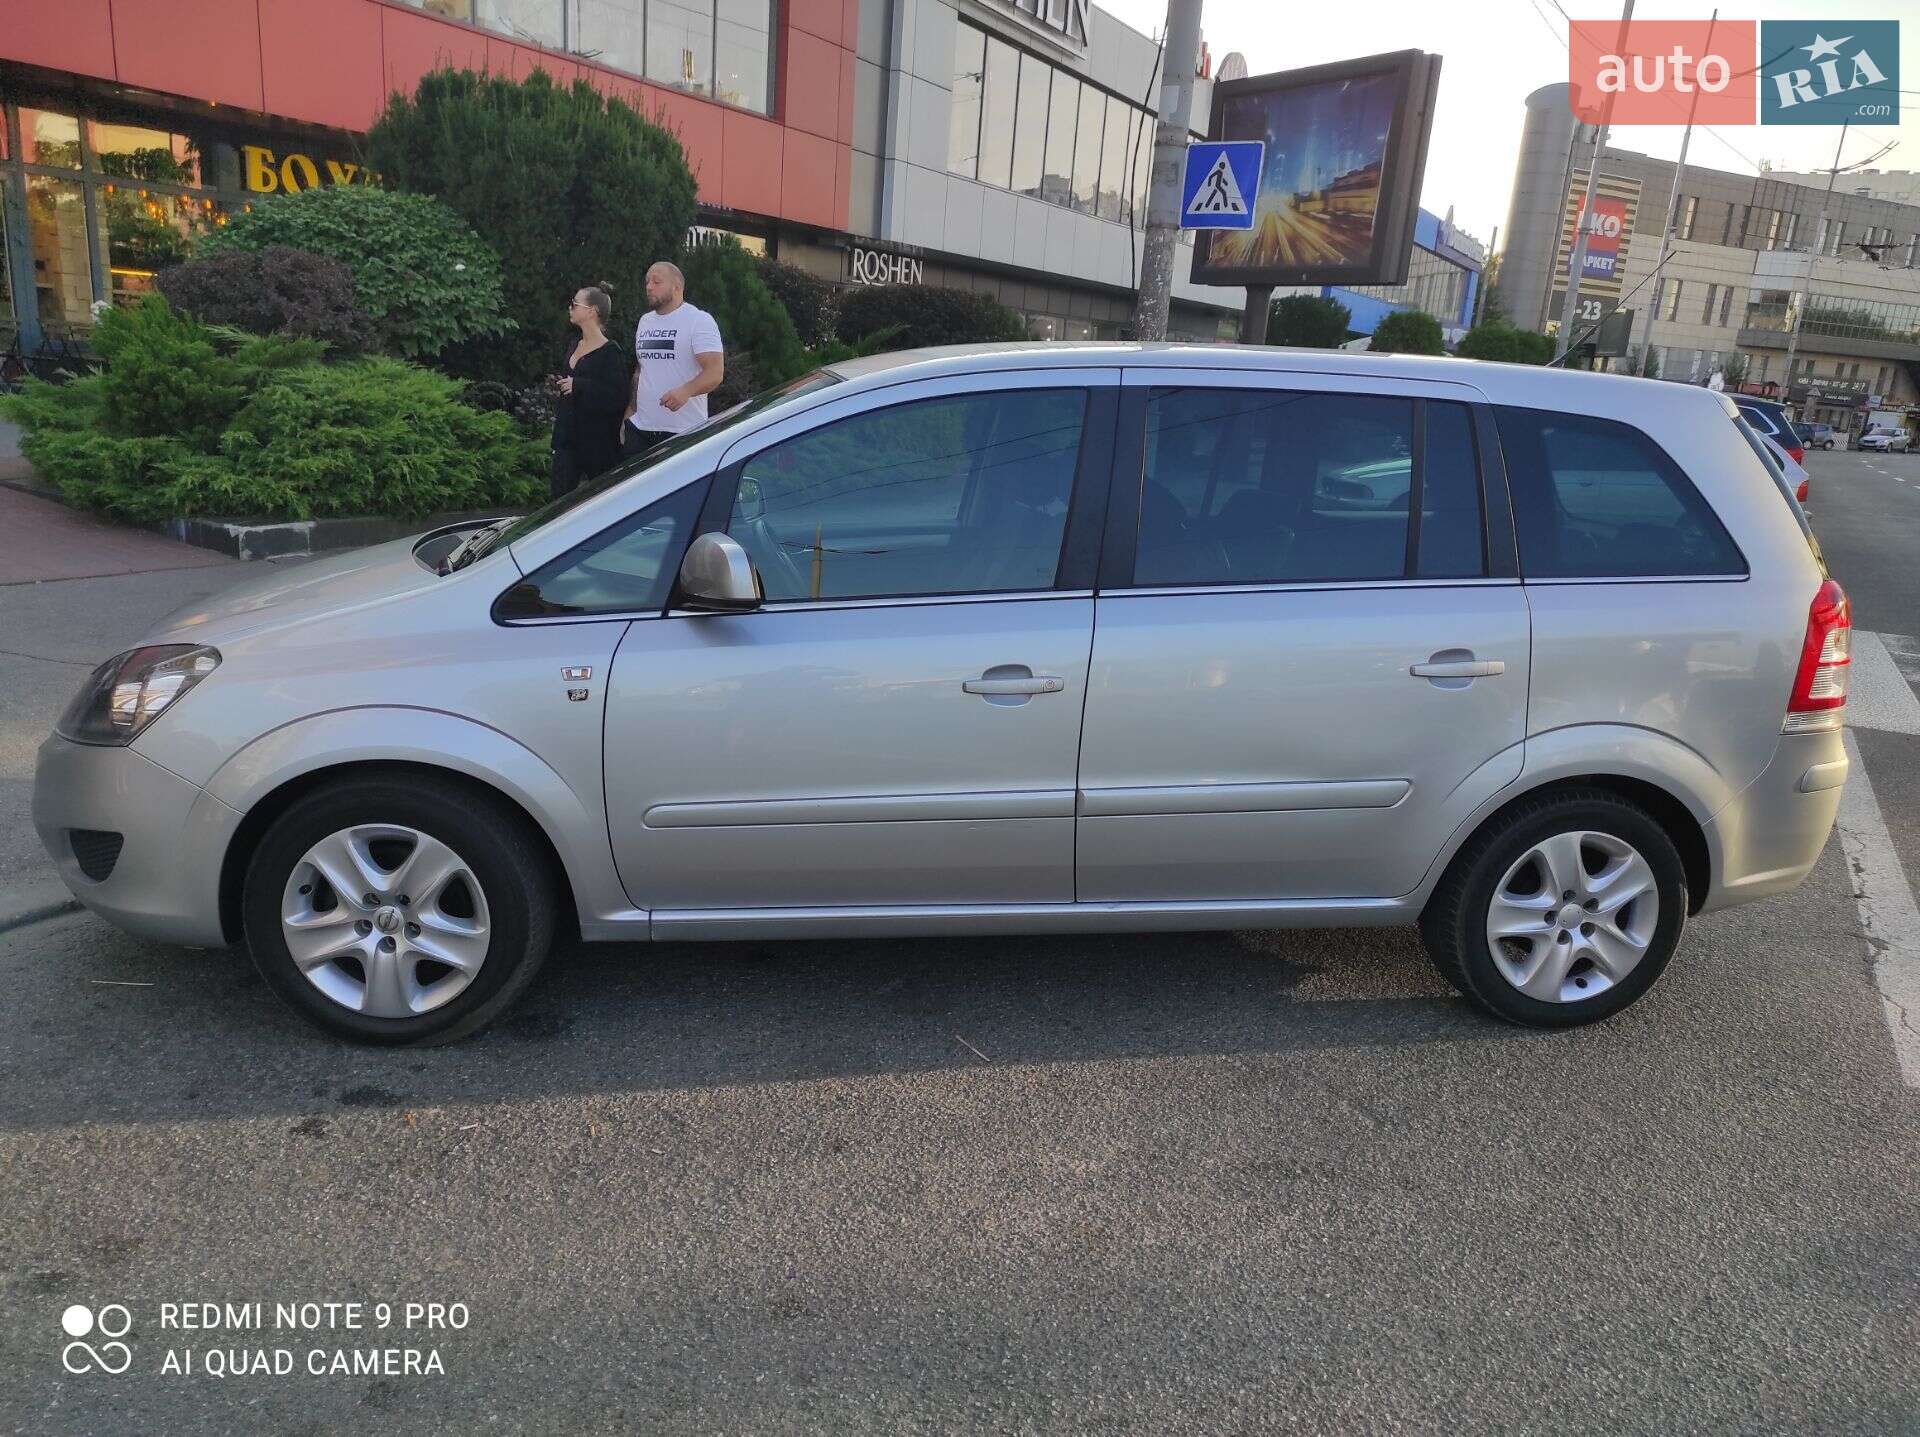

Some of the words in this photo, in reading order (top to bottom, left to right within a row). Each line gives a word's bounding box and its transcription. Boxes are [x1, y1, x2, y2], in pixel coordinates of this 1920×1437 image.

[853, 248, 923, 285] ROSHEN
[1570, 254, 1615, 270] РКЕТ
[640, 329, 678, 338] UNDER
